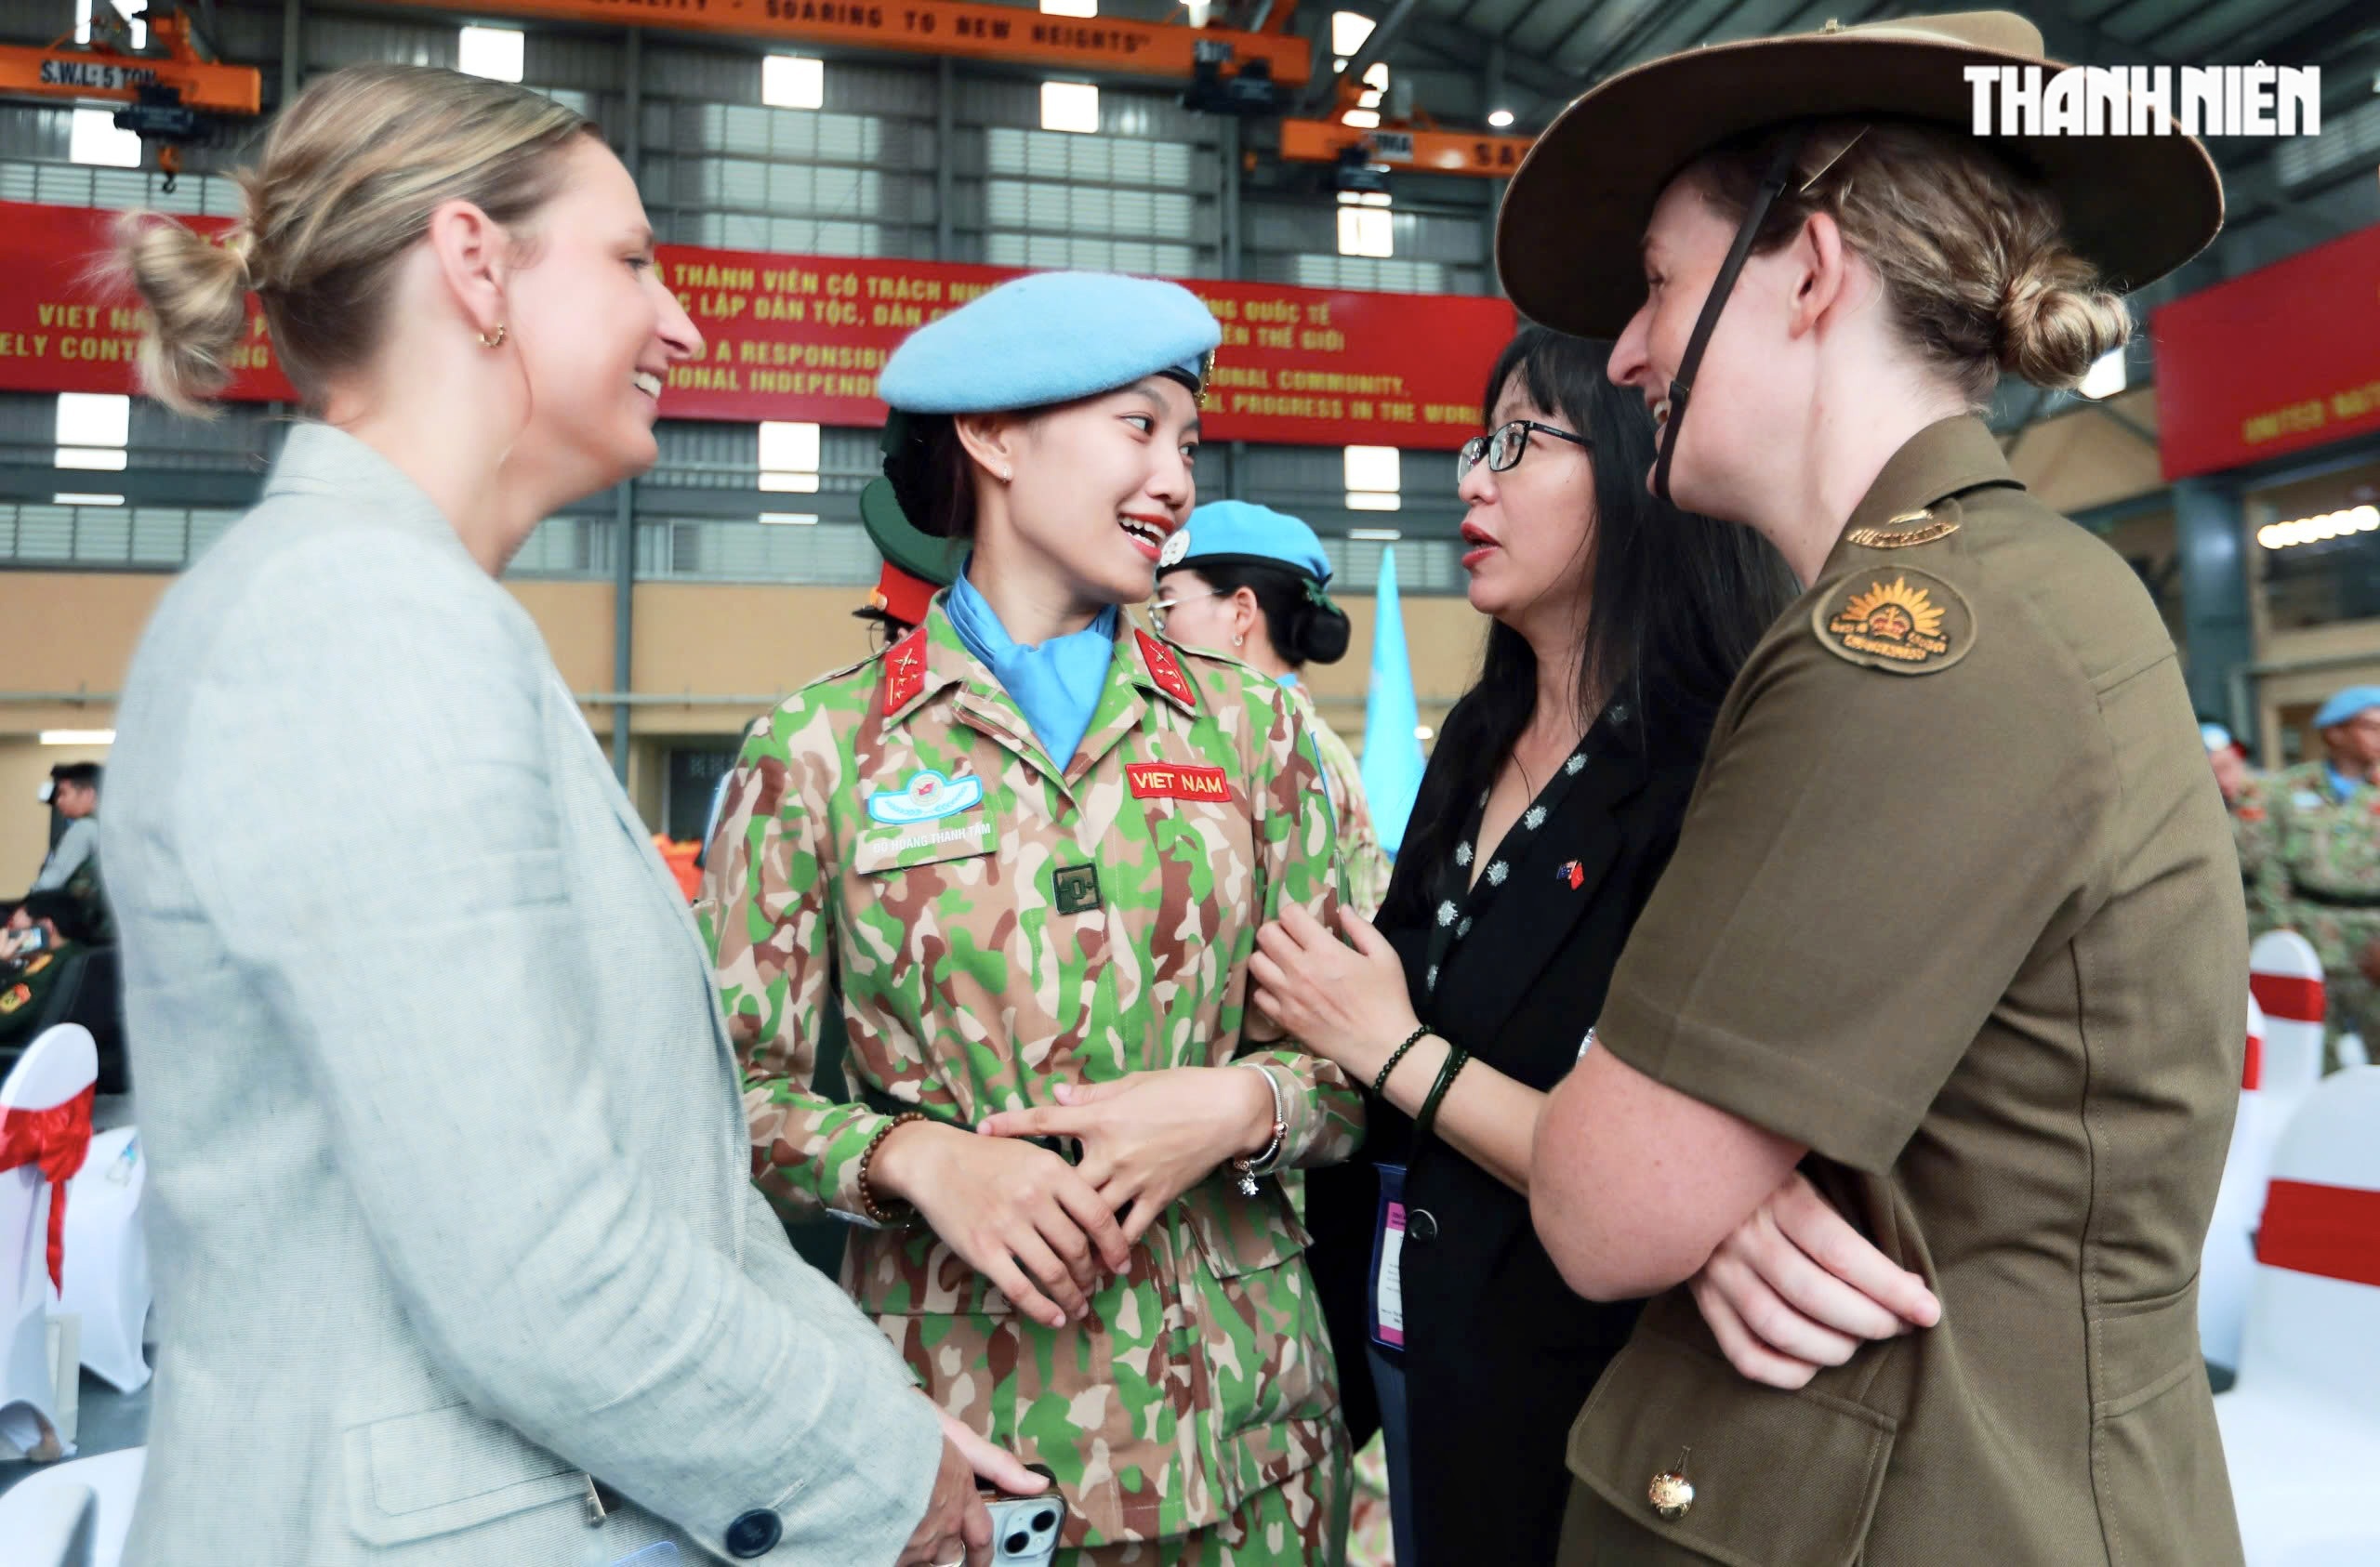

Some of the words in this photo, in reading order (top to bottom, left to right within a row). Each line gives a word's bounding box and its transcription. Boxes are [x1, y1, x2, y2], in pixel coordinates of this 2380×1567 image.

[766, 0, 881, 28] SOARING
[905, 10, 936, 34] TO
[956, 16, 1011, 39] NEW
[103, 66, 115, 88] 5
[38, 304, 98, 328] VIET
[716, 339, 732, 362] A
[740, 341, 886, 371] RESPONSIBL
[668, 366, 742, 391] IONAL
[749, 371, 879, 399] INDEPEND
[1233, 394, 1343, 418] PROGRESS
[1352, 401, 1374, 420] IN
[1381, 402, 1415, 423] THE
[1423, 404, 1486, 426] WORL
[1132, 772, 1175, 789] VIET
[1181, 775, 1223, 794] NAM
